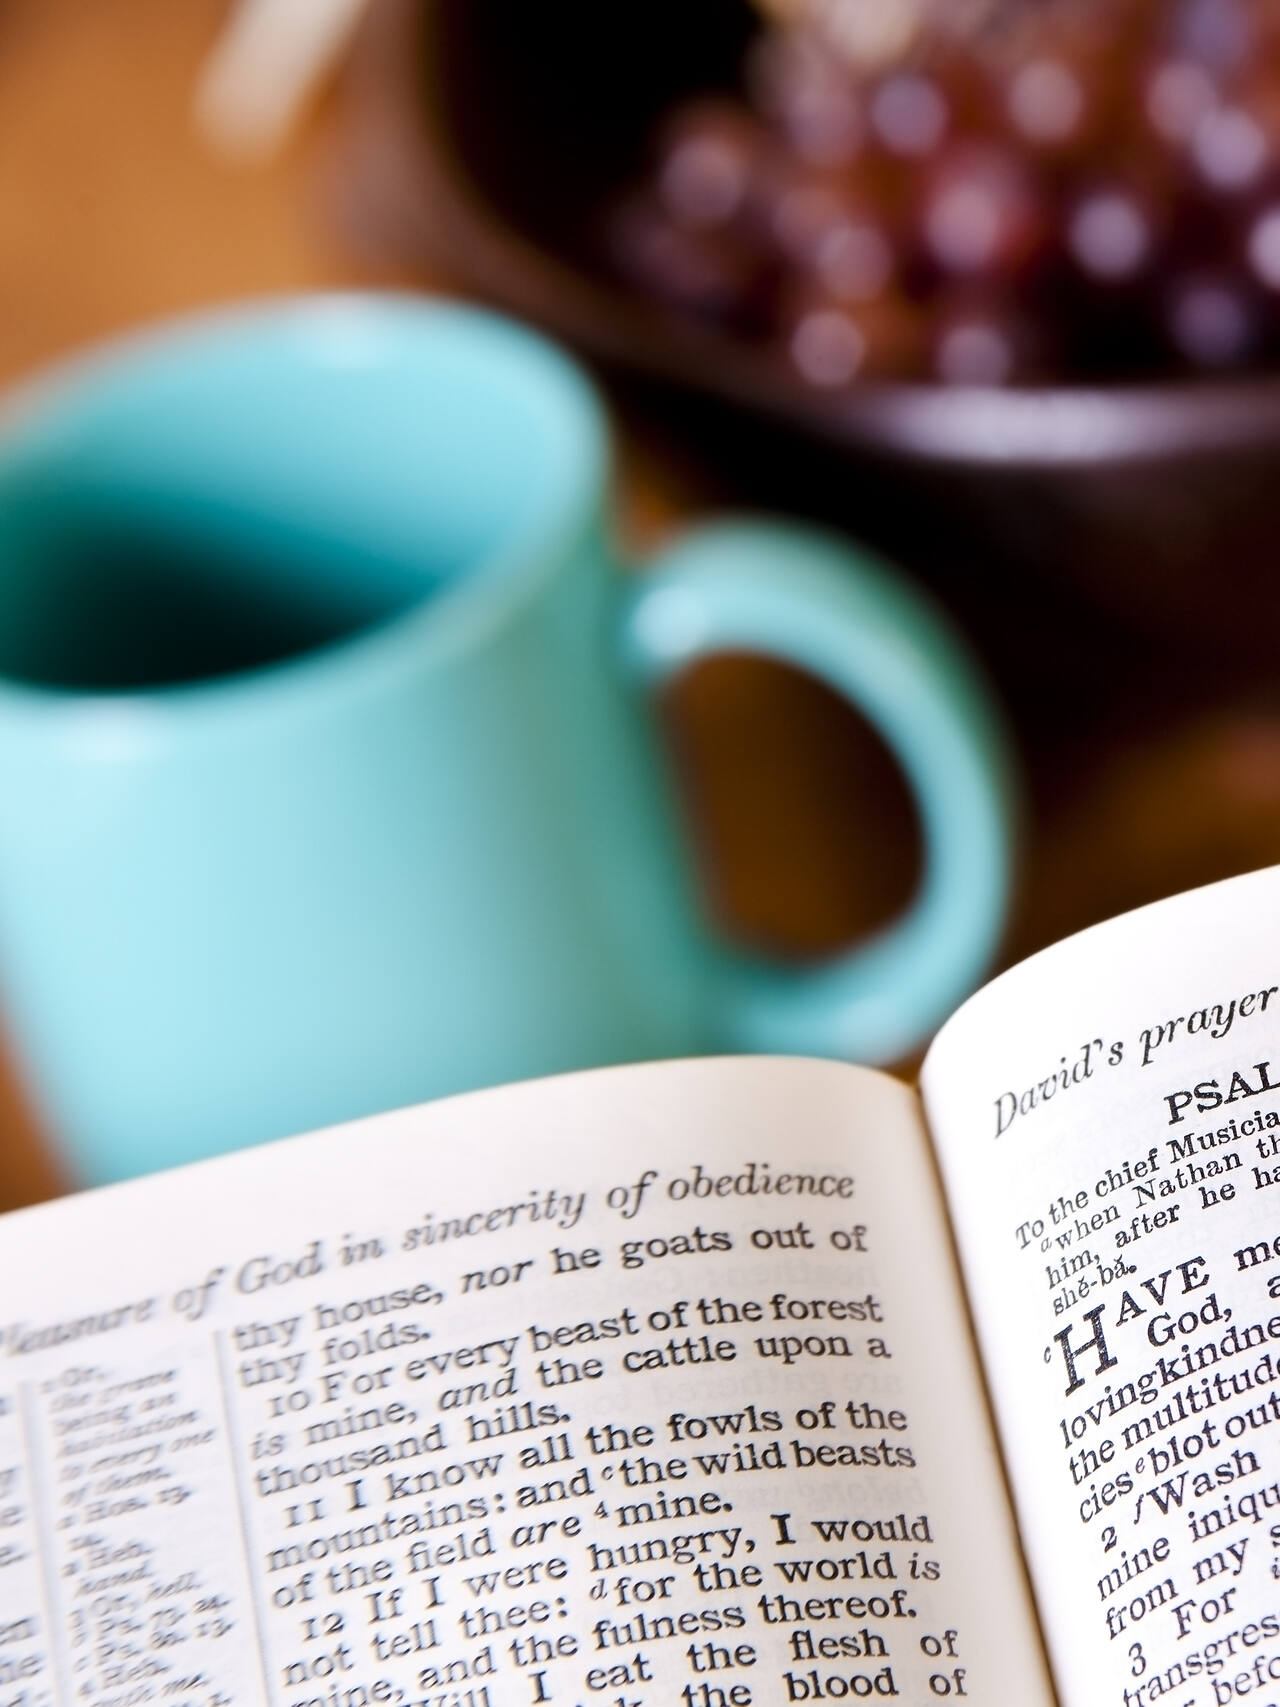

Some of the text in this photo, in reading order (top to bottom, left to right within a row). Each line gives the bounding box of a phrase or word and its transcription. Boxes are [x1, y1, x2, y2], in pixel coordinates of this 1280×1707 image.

[994, 1038, 1124, 1138] David's
[1140, 985, 1279, 1068] prayer
[1015, 1219, 1045, 1250] To
[1048, 1190, 1089, 1225] the
[1094, 1147, 1161, 1198] chief
[1131, 1152, 1244, 1210] Nathan
[173, 1162, 854, 1322] of God in sincerity of obedience
[462, 1221, 868, 1294] nor he goats out of
[1046, 1249, 1101, 1290] him,
[1114, 1204, 1181, 1249] after
[1197, 1182, 1236, 1210] he
[406, 1293, 884, 1381] every beast of the forest
[1147, 1292, 1233, 1348] God,
[535, 1335, 892, 1389] the cattle upon a
[665, 1400, 908, 1443] fowls of the
[1069, 1439, 1116, 1486] the
[462, 1512, 934, 1597] were hungry, I would
[692, 1550, 941, 1593] the world is
[1105, 1578, 1179, 1641] from
[1192, 1537, 1250, 1586] my
[685, 1627, 959, 1674] the flesh of
